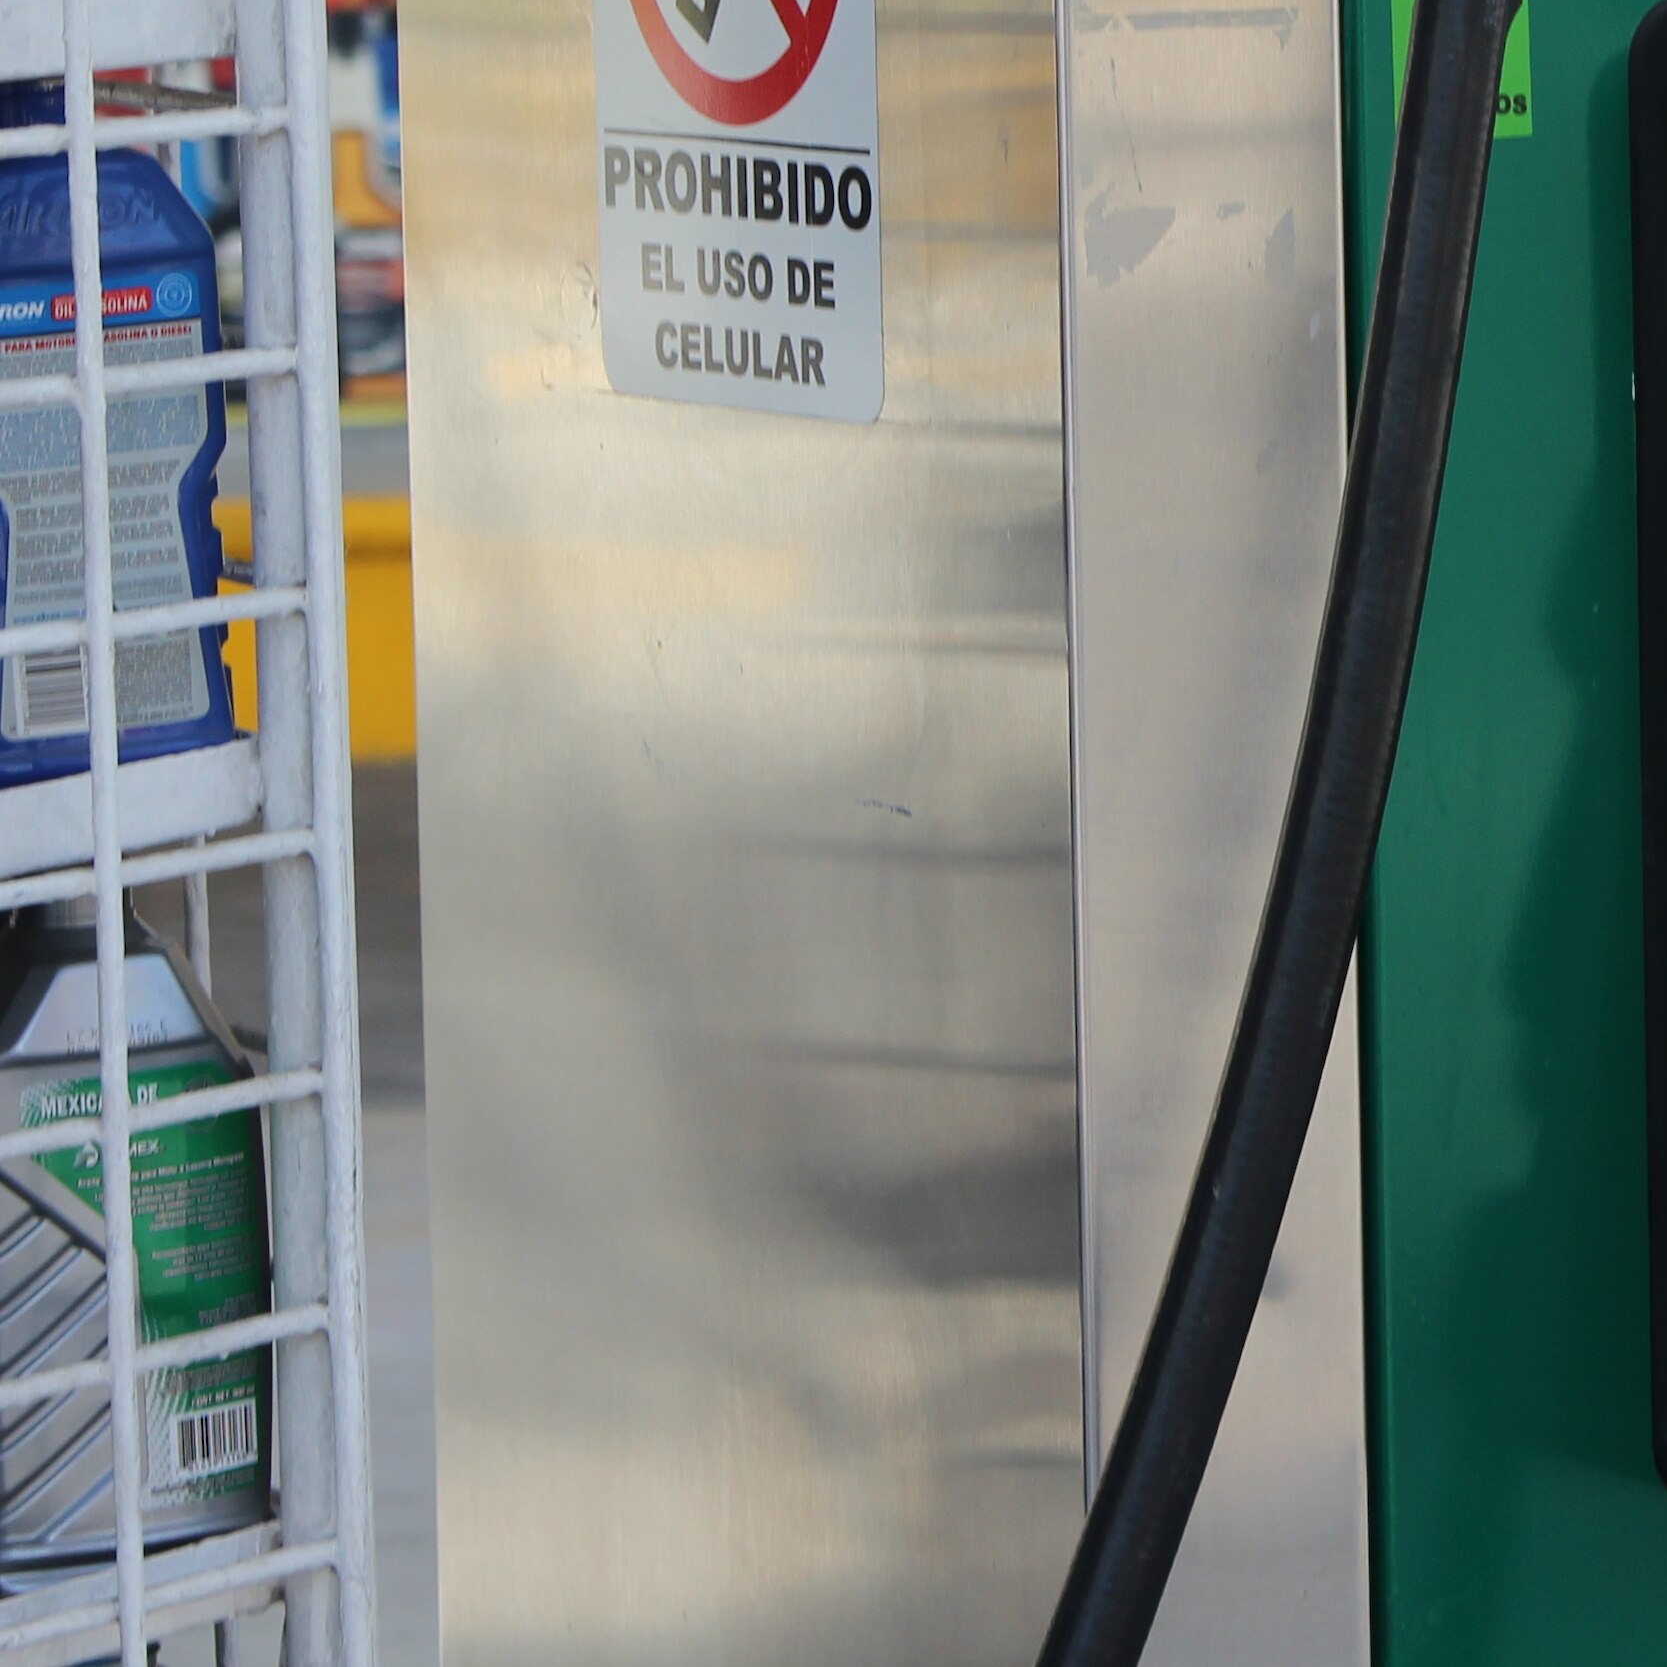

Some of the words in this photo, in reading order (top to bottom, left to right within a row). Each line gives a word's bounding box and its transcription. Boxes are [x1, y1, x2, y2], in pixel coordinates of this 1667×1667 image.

[603, 146, 873, 231] PROHIBIDO
[640, 241, 685, 294] EL
[695, 247, 774, 306] USO
[786, 259, 837, 310] DE
[653, 322, 826, 388] CELULAR
